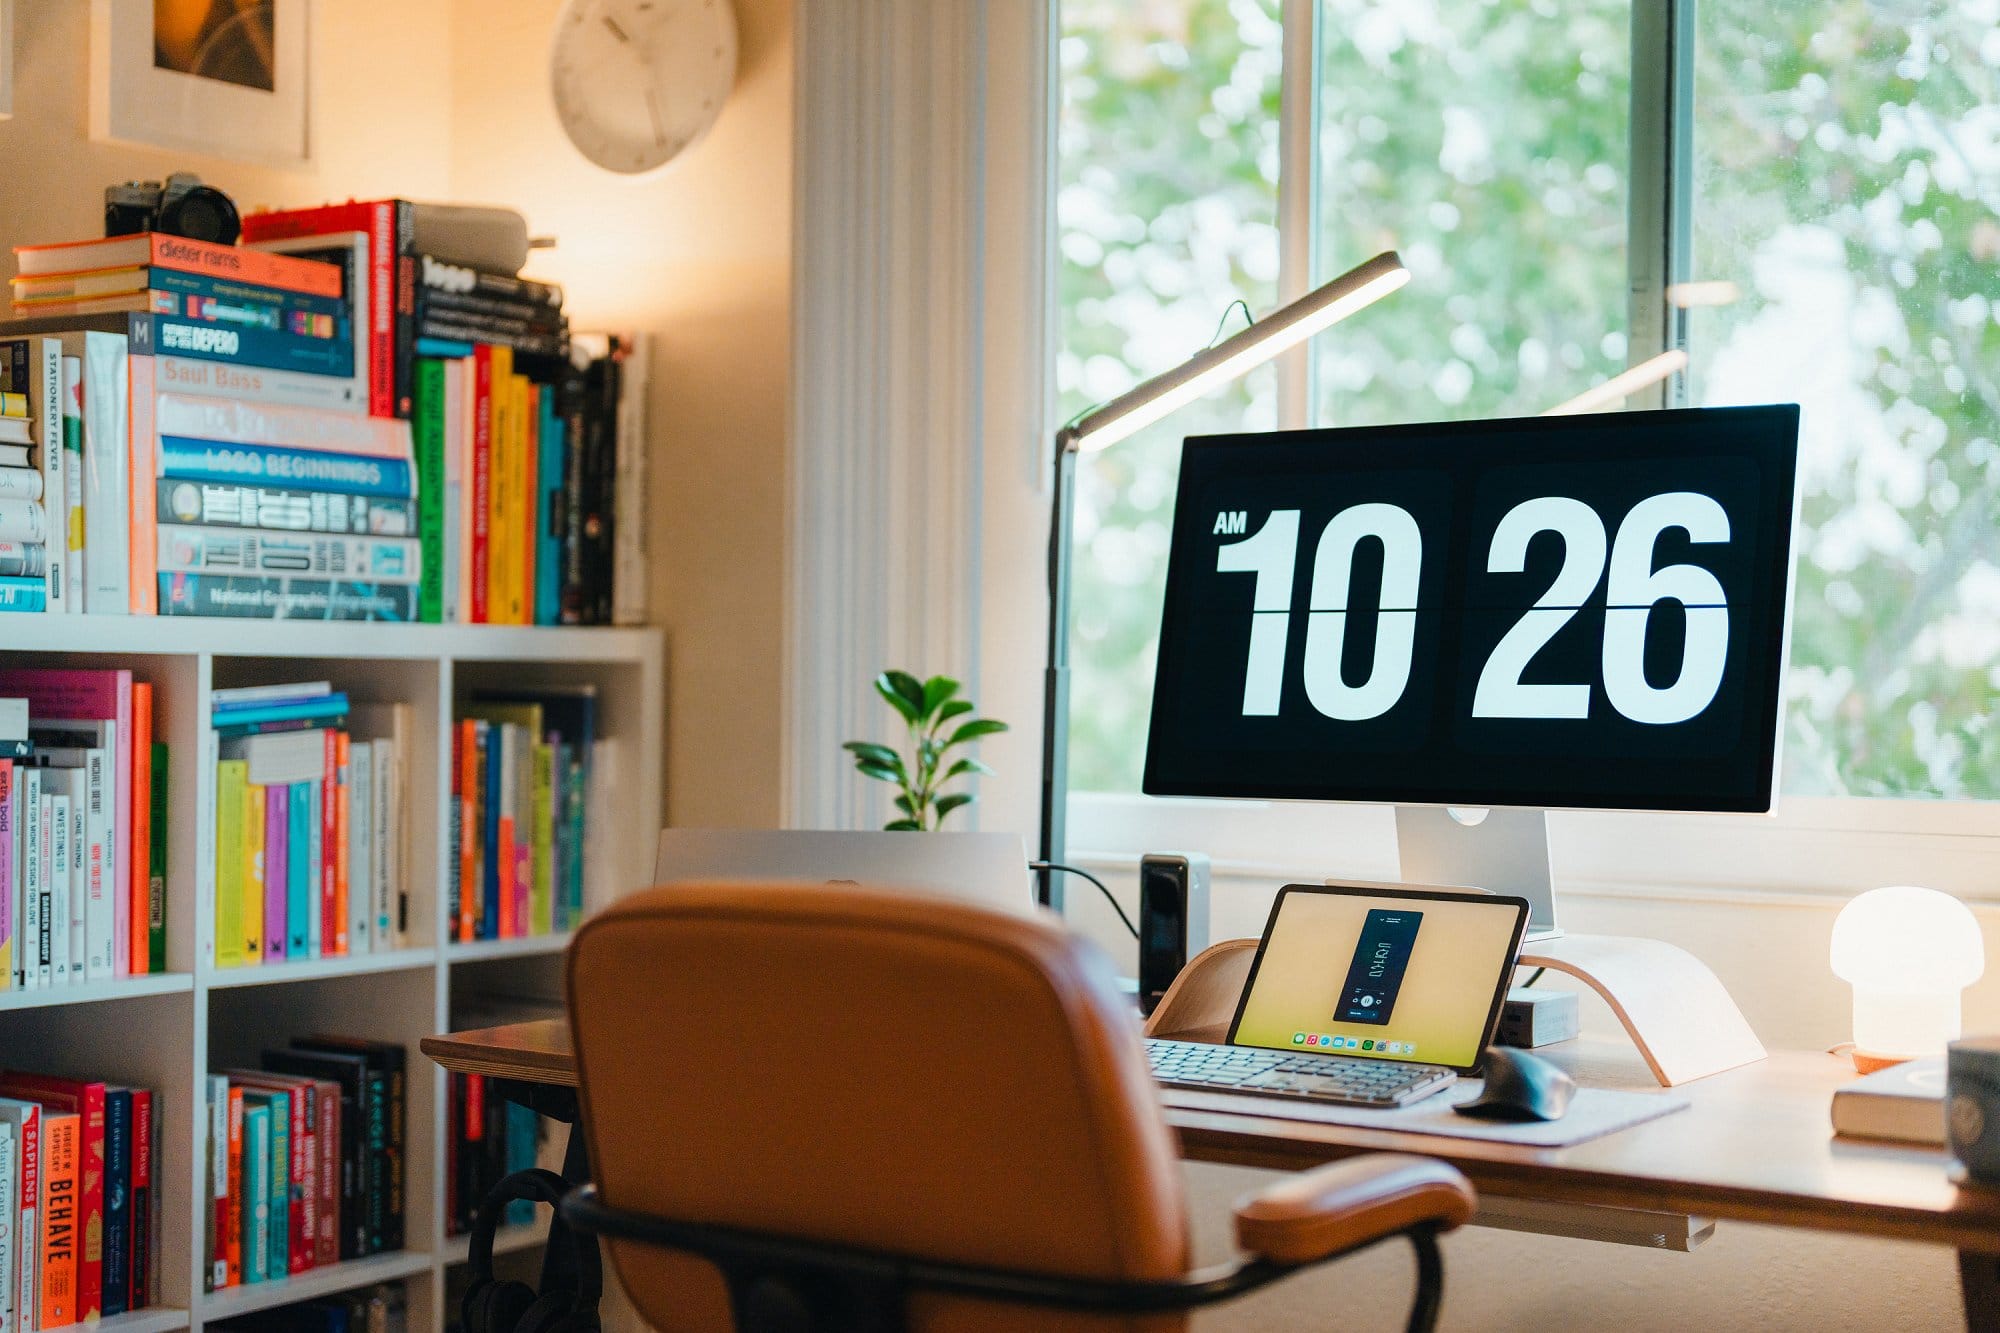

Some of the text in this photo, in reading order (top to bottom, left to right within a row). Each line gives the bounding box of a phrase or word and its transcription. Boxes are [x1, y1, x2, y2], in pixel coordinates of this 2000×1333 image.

[159, 239, 240, 269] dieter rams
[135, 321, 148, 344] M
[164, 359, 209, 386] Saul
[215, 365, 262, 391] Bass
[50, 353, 58, 471] STATIONERY FEVER
[206, 448, 382, 486] LOGO BEGINNINGS
[202, 484, 240, 523] THE
[258, 488, 311, 531] OF
[1213, 511, 1247, 535] AM
[261, 538, 310, 570] OF
[210, 587, 261, 606] National
[263, 591, 328, 612] Geographic
[1217, 492, 1730, 724] 10 26
[0, 771, 8, 801] extra
[0, 804, 8, 832] bold
[56, 806, 65, 856] INVESTING
[74, 813, 82, 869] ONE THING
[0, 1135, 9, 1173] Adam
[25, 1130, 37, 1203] SAPIENS
[0, 1178, 8, 1217] Grant
[48, 1179, 73, 1264] BEHAVE
